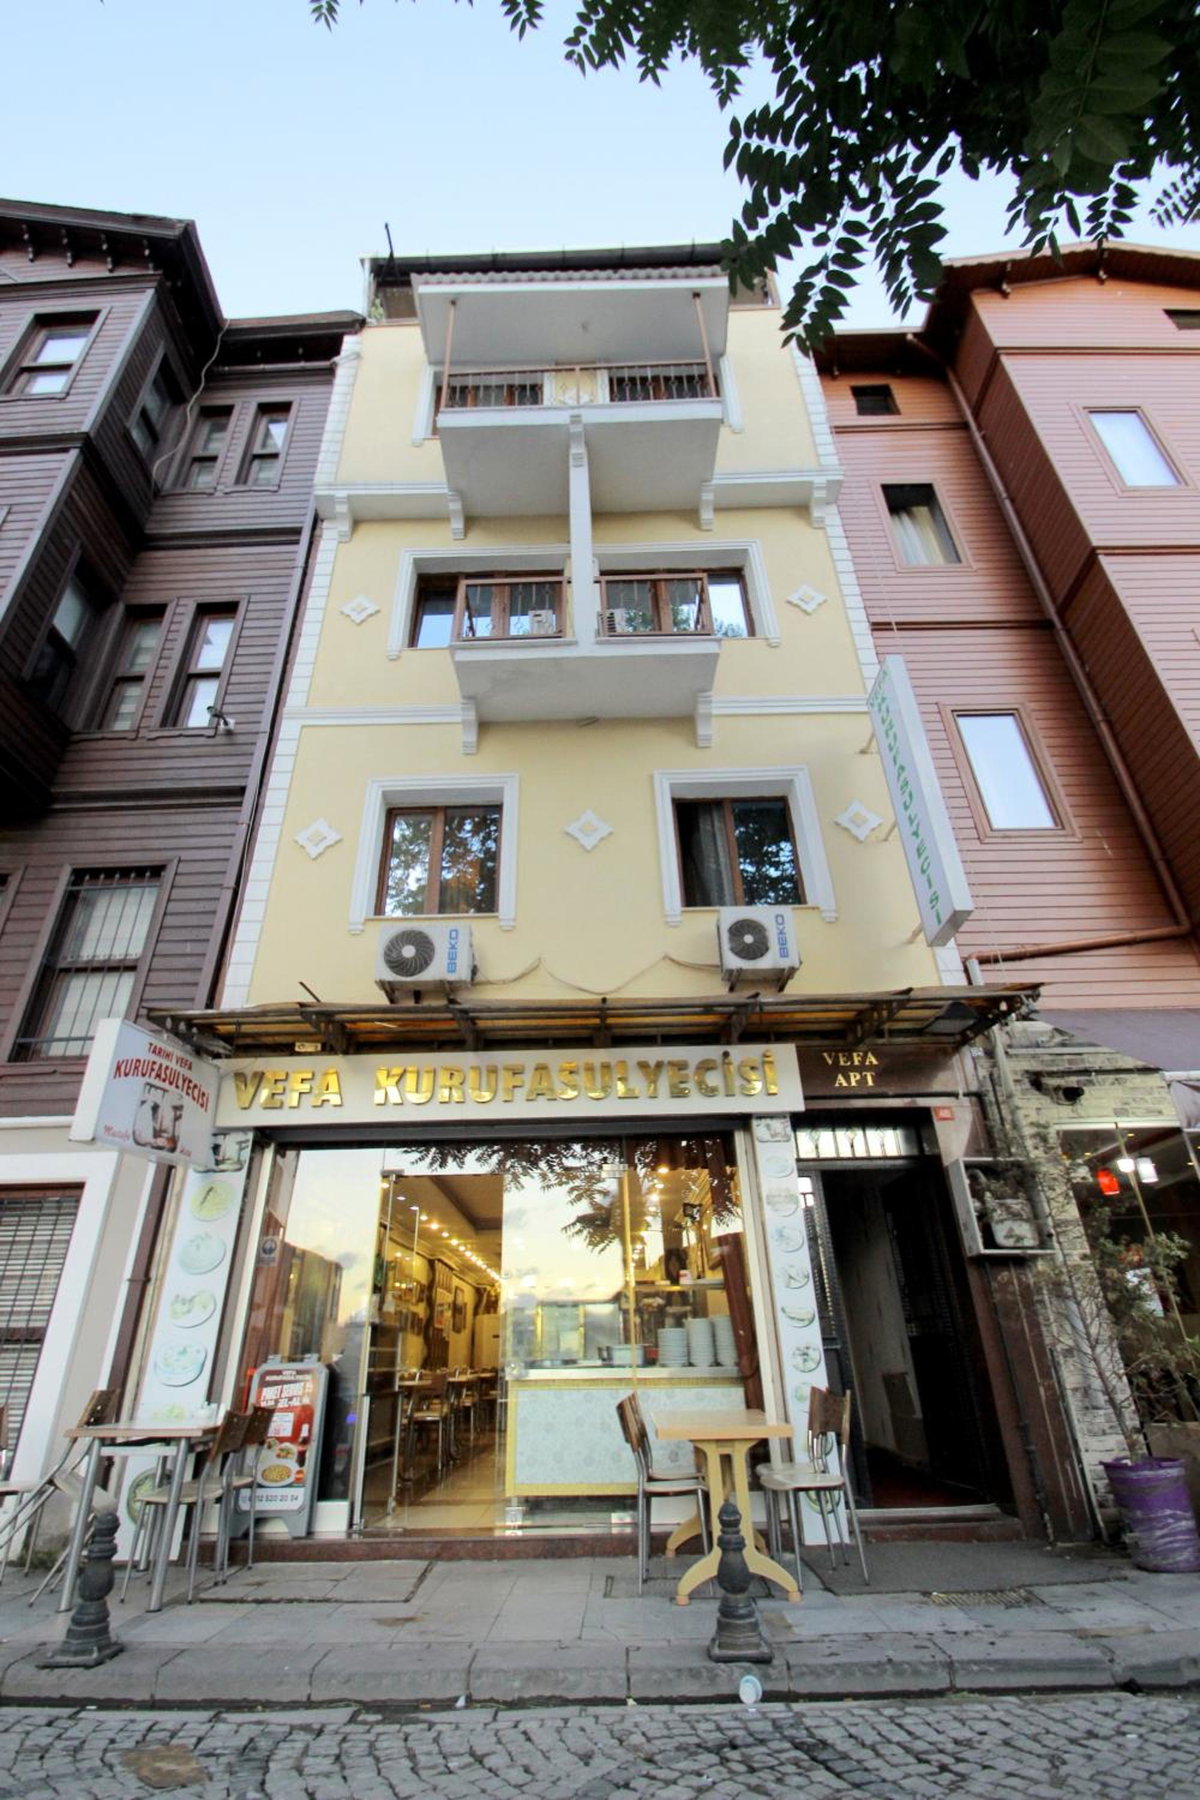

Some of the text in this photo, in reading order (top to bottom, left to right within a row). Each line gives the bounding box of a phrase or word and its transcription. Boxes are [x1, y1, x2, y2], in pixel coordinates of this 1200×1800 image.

[447, 929, 458, 973] BEKO
[775, 914, 789, 958] BEKO
[176, 1055, 193, 1071] VEFA
[822, 1051, 879, 1066] VEFA
[234, 1049, 779, 1109] VEFA KURUFASULYECİSİ
[834, 1071, 876, 1087] APT
